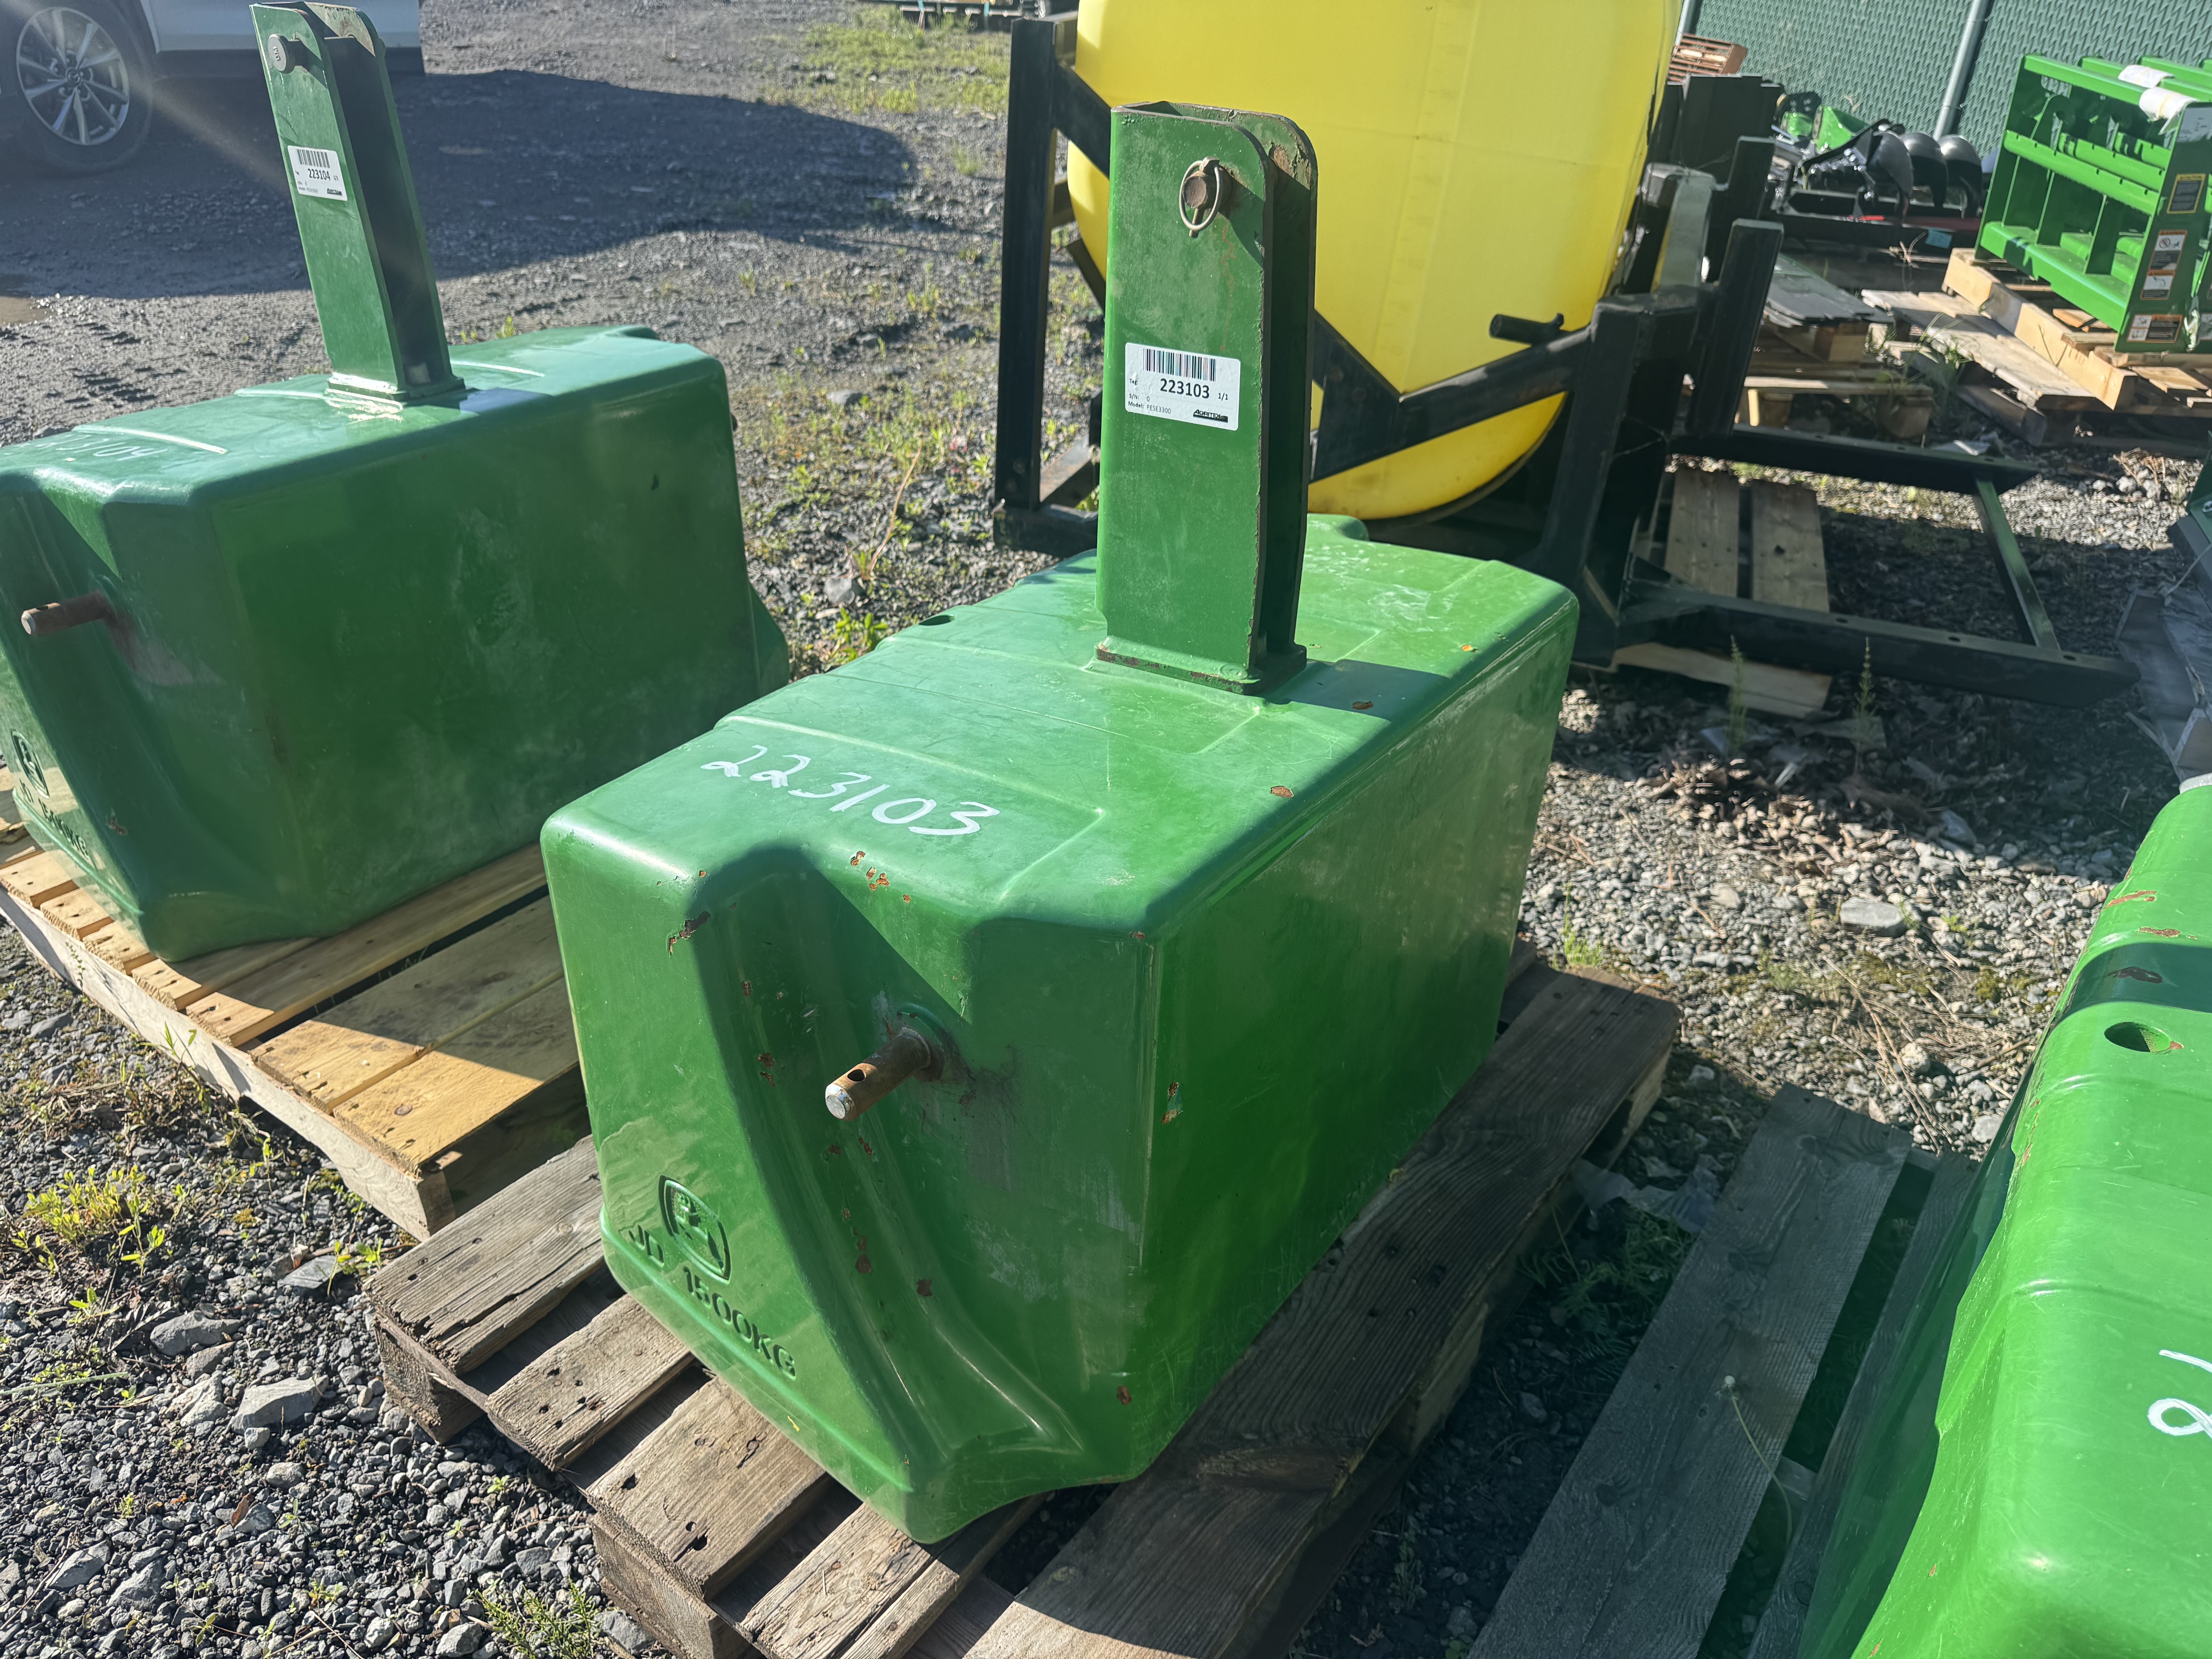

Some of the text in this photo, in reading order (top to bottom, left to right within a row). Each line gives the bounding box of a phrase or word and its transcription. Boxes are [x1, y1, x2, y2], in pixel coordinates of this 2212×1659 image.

[307, 168, 330, 181] 223104
[1160, 378, 1210, 399] 223103
[1218, 392, 1228, 400] 1/1
[1128, 401, 1171, 414] Model: PESE3300
[700, 744, 1000, 836] 223103
[683, 1266, 797, 1381] 1500KG
